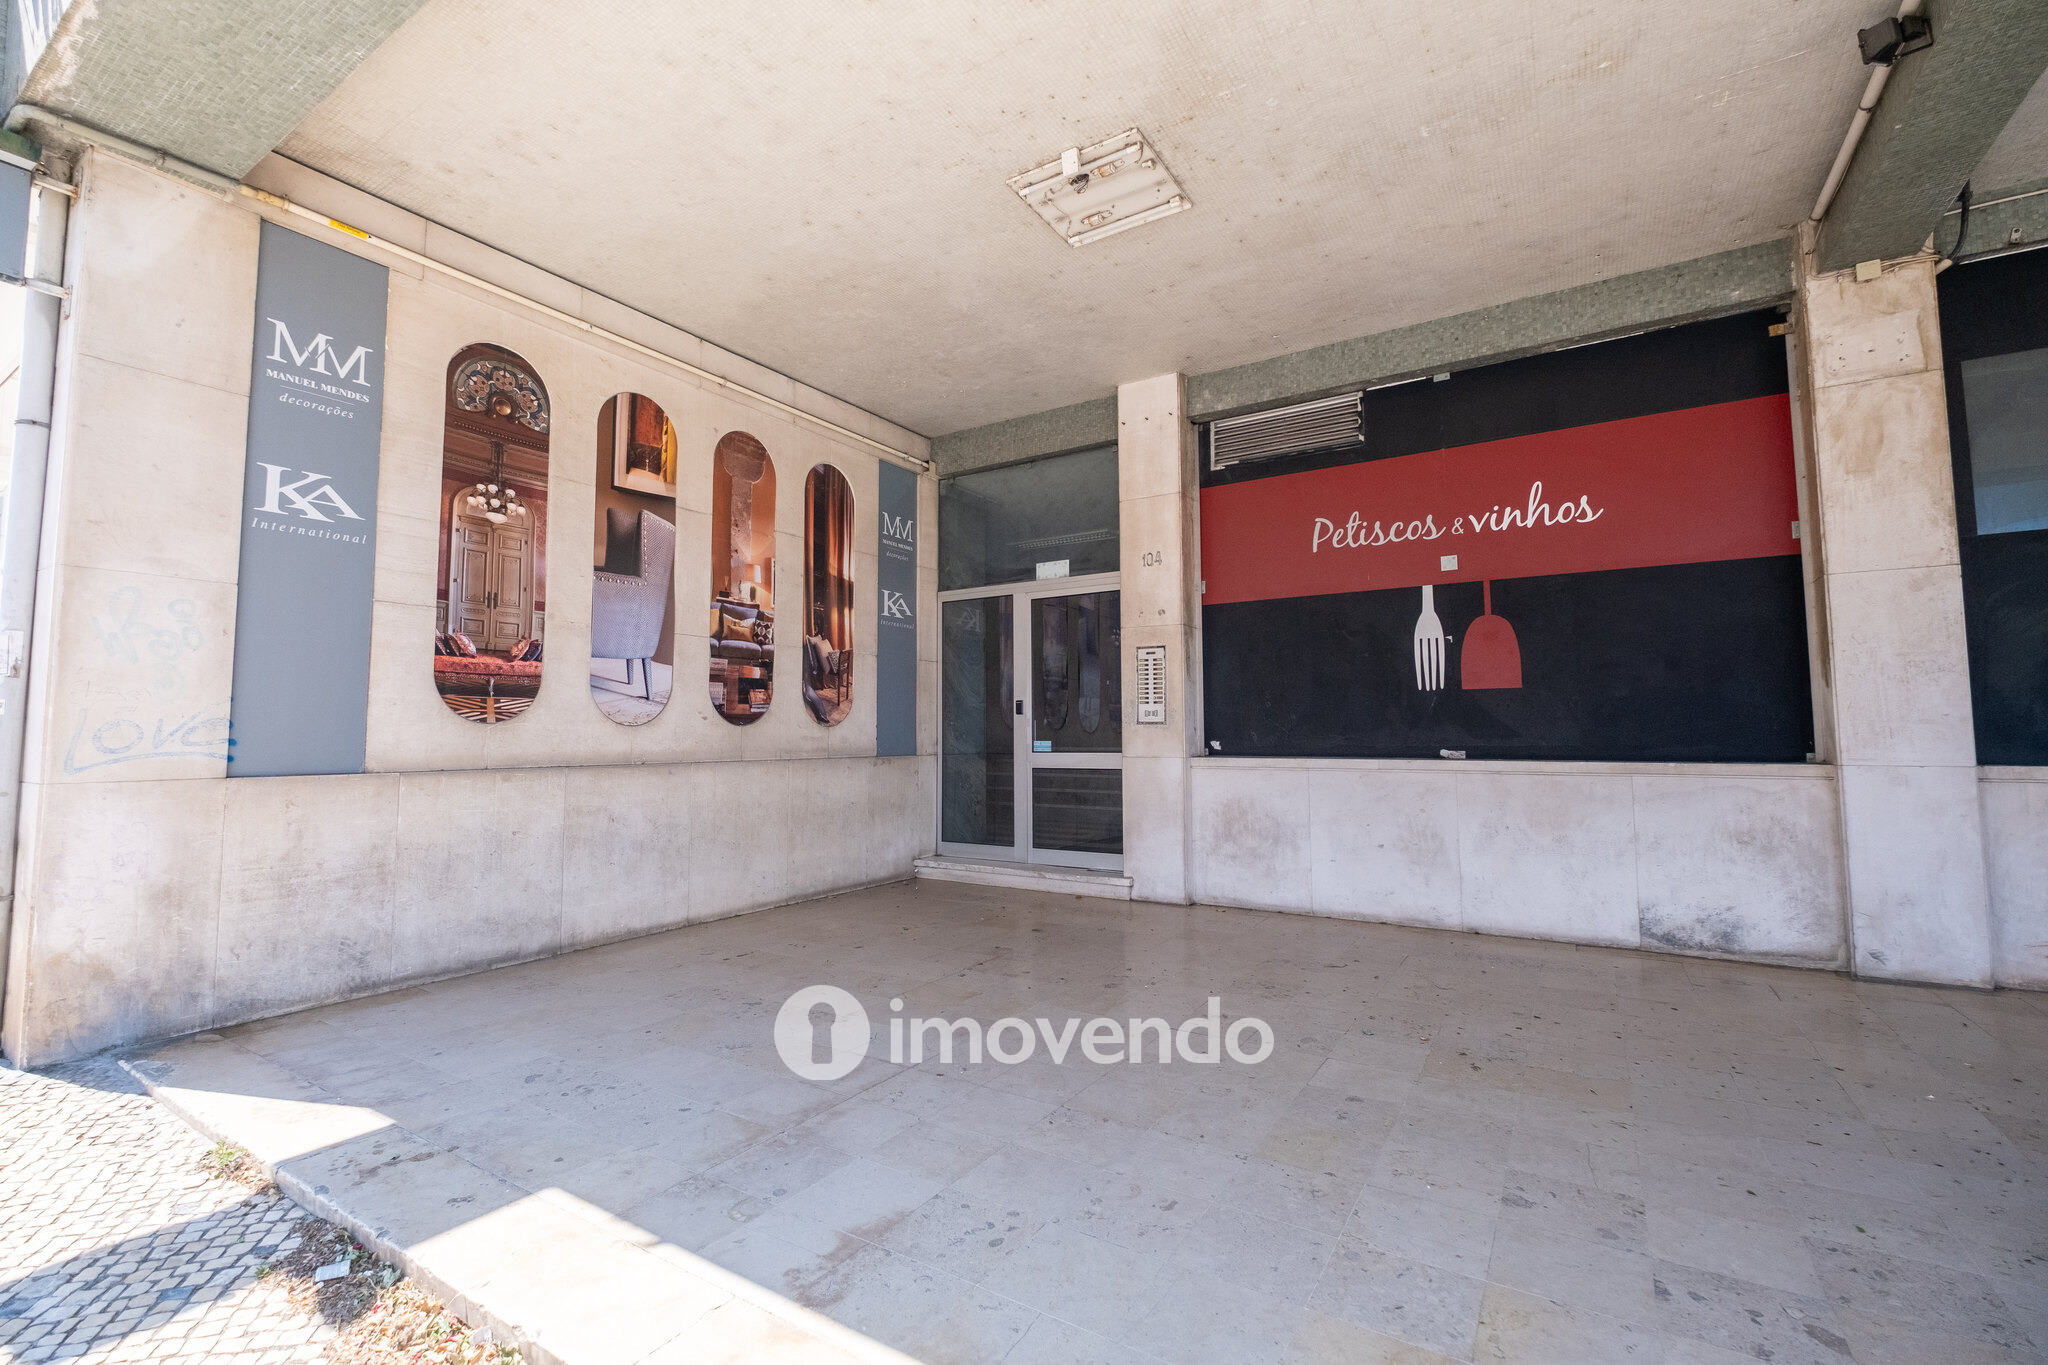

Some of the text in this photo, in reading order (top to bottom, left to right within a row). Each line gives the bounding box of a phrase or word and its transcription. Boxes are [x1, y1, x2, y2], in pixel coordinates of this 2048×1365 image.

[265, 317, 374, 387] MM
[265, 368, 370, 403] MANUEL MENDES
[279, 393, 354, 419] decorações
[253, 461, 366, 523] KA
[251, 517, 367, 544] International
[1312, 481, 1604, 553] Petiscos & vinhos
[881, 589, 914, 619] KA
